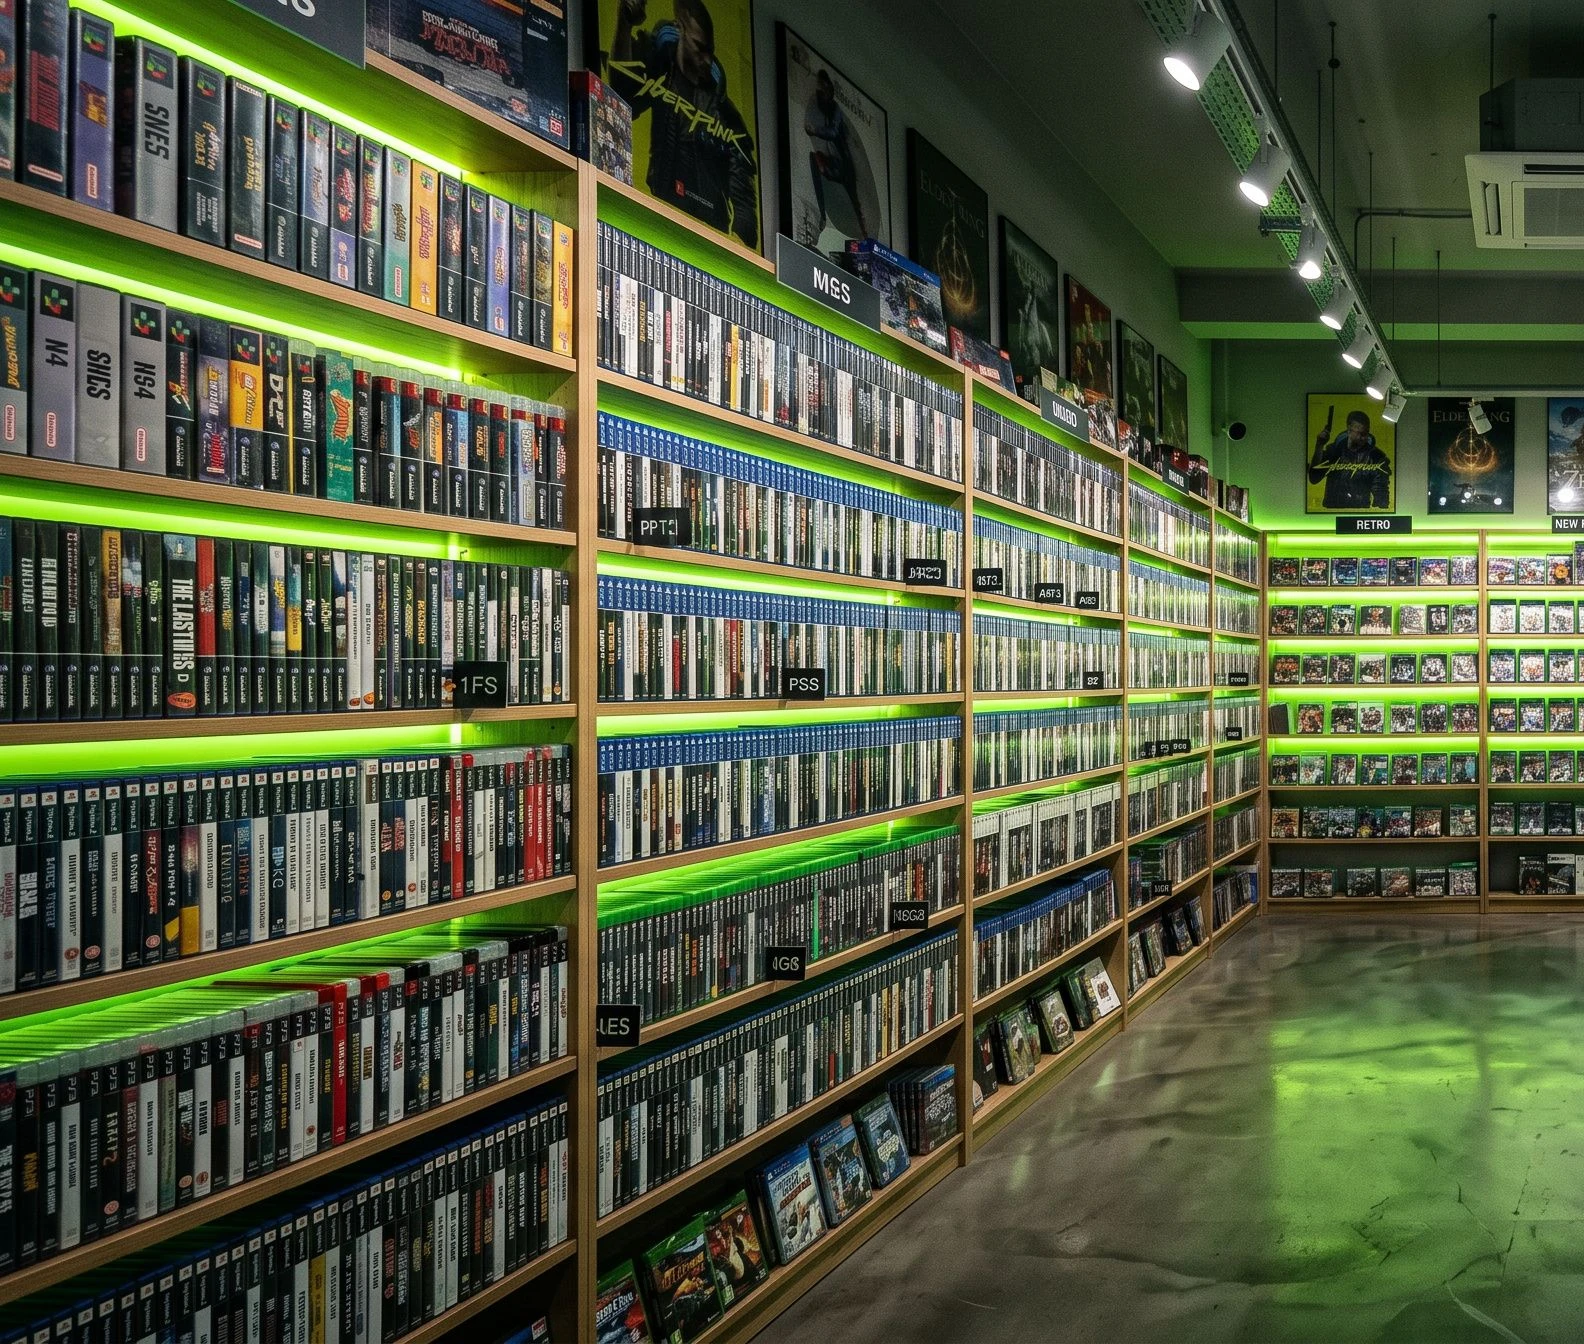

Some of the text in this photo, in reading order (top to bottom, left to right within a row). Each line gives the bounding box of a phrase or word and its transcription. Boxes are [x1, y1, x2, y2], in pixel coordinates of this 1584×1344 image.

[144, 102, 170, 160] SNES
[45, 338, 68, 367] N4
[1356, 520, 1390, 530] RETRO
[1555, 519, 1579, 529] NEW
[172, 579, 193, 601] THE
[461, 676, 498, 694] 1FS
[789, 677, 819, 691] PSS
